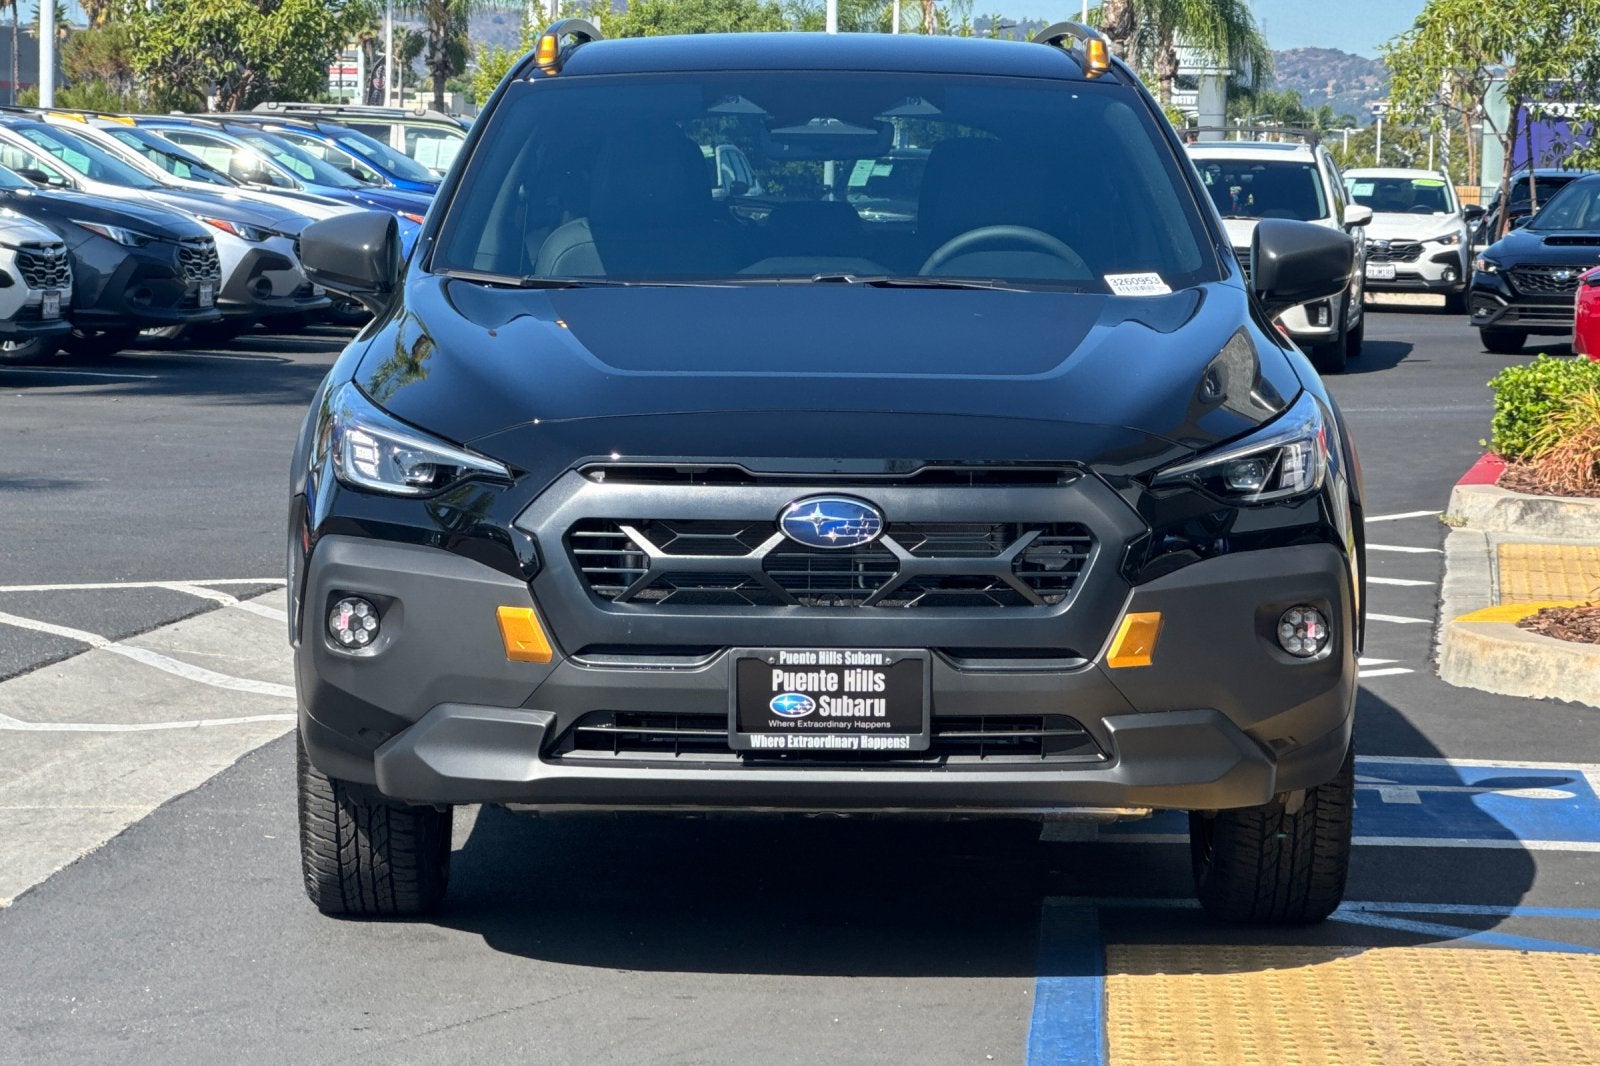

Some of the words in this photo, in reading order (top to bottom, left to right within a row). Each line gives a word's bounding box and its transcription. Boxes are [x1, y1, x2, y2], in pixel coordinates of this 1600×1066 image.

[779, 651, 818, 665] Puente
[819, 651, 843, 665] Hills
[844, 651, 883, 666] Subaru
[772, 669, 839, 692] Puente
[844, 668, 886, 692] Hills
[819, 695, 886, 717] Subaru
[768, 720, 795, 728] Where
[797, 720, 852, 729] Extraordinary
[854, 720, 891, 729] Happens
[750, 735, 786, 748] Where
[787, 735, 859, 750] Extraordinary
[860, 735, 910, 750] Happens!
